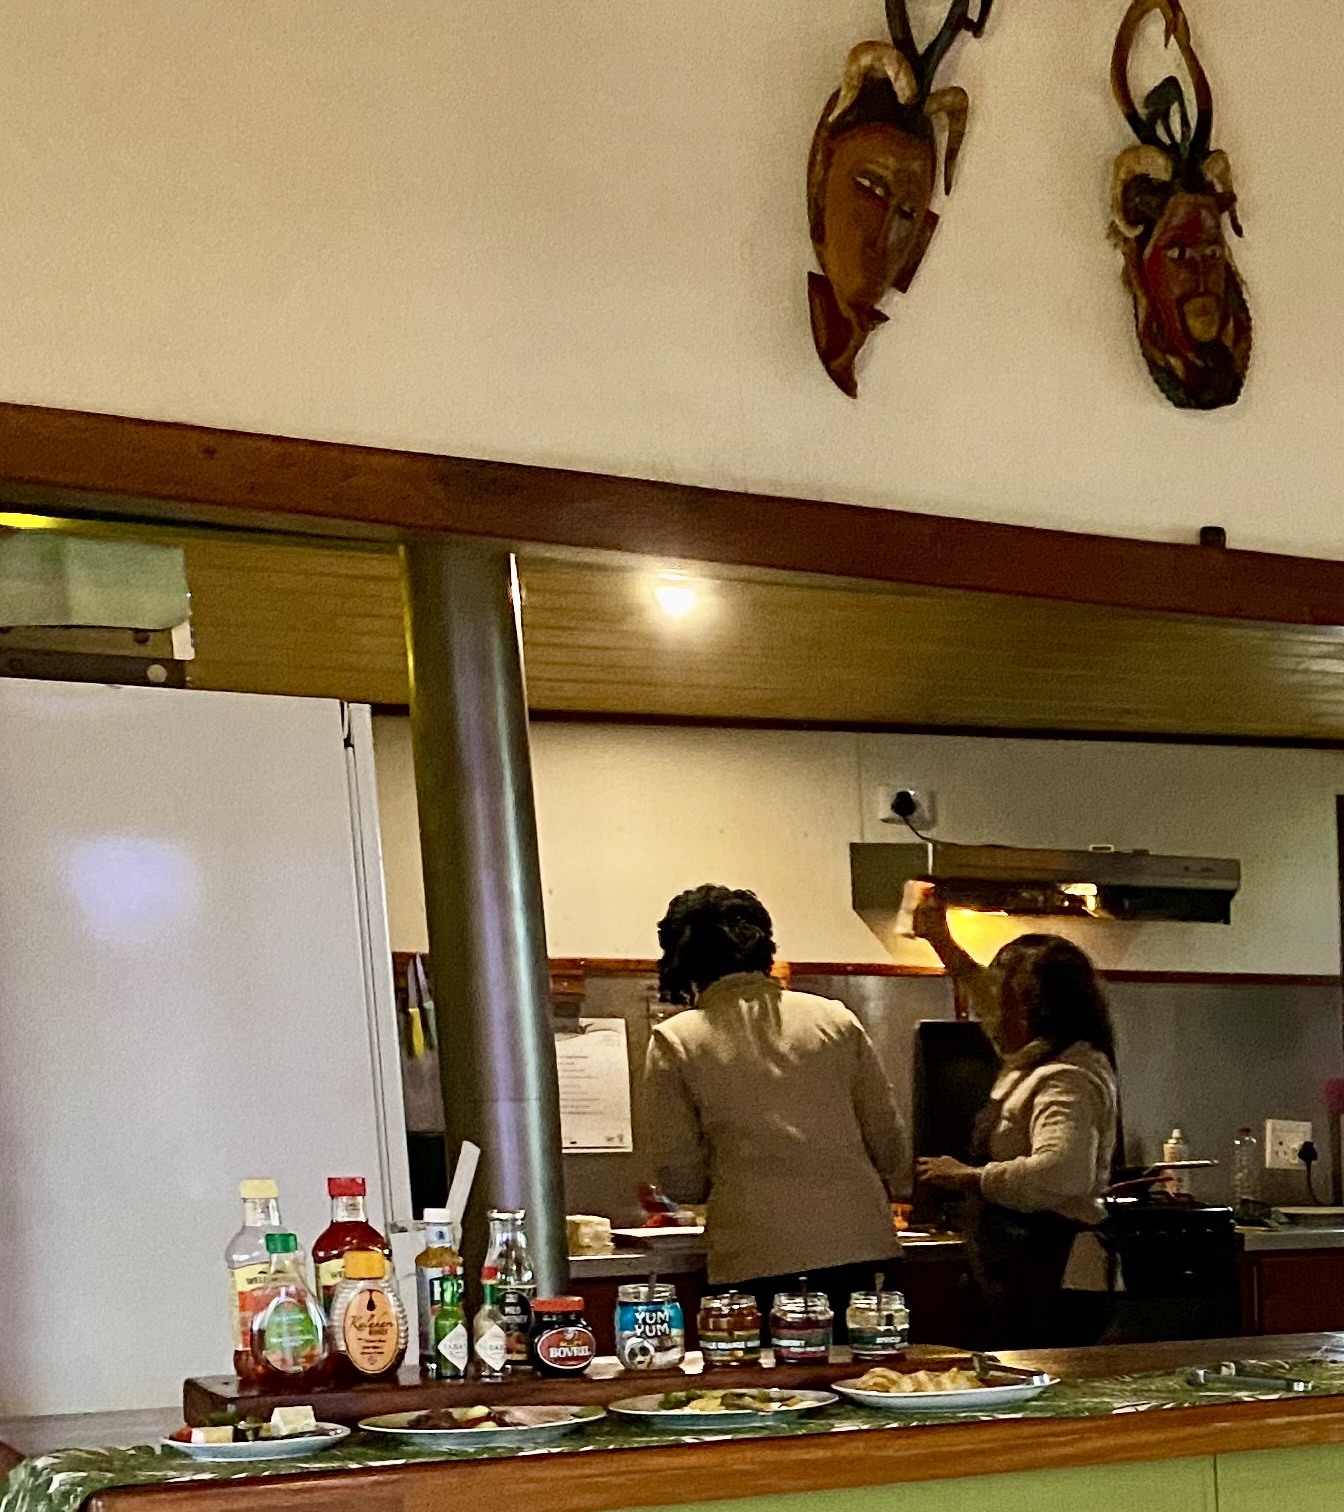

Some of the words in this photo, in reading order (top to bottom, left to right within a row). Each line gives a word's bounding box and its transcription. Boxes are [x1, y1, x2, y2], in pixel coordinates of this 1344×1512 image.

[634, 1311, 670, 1324] YUM
[634, 1323, 670, 1337] YUM
[549, 1345, 592, 1359] BOVRIL
